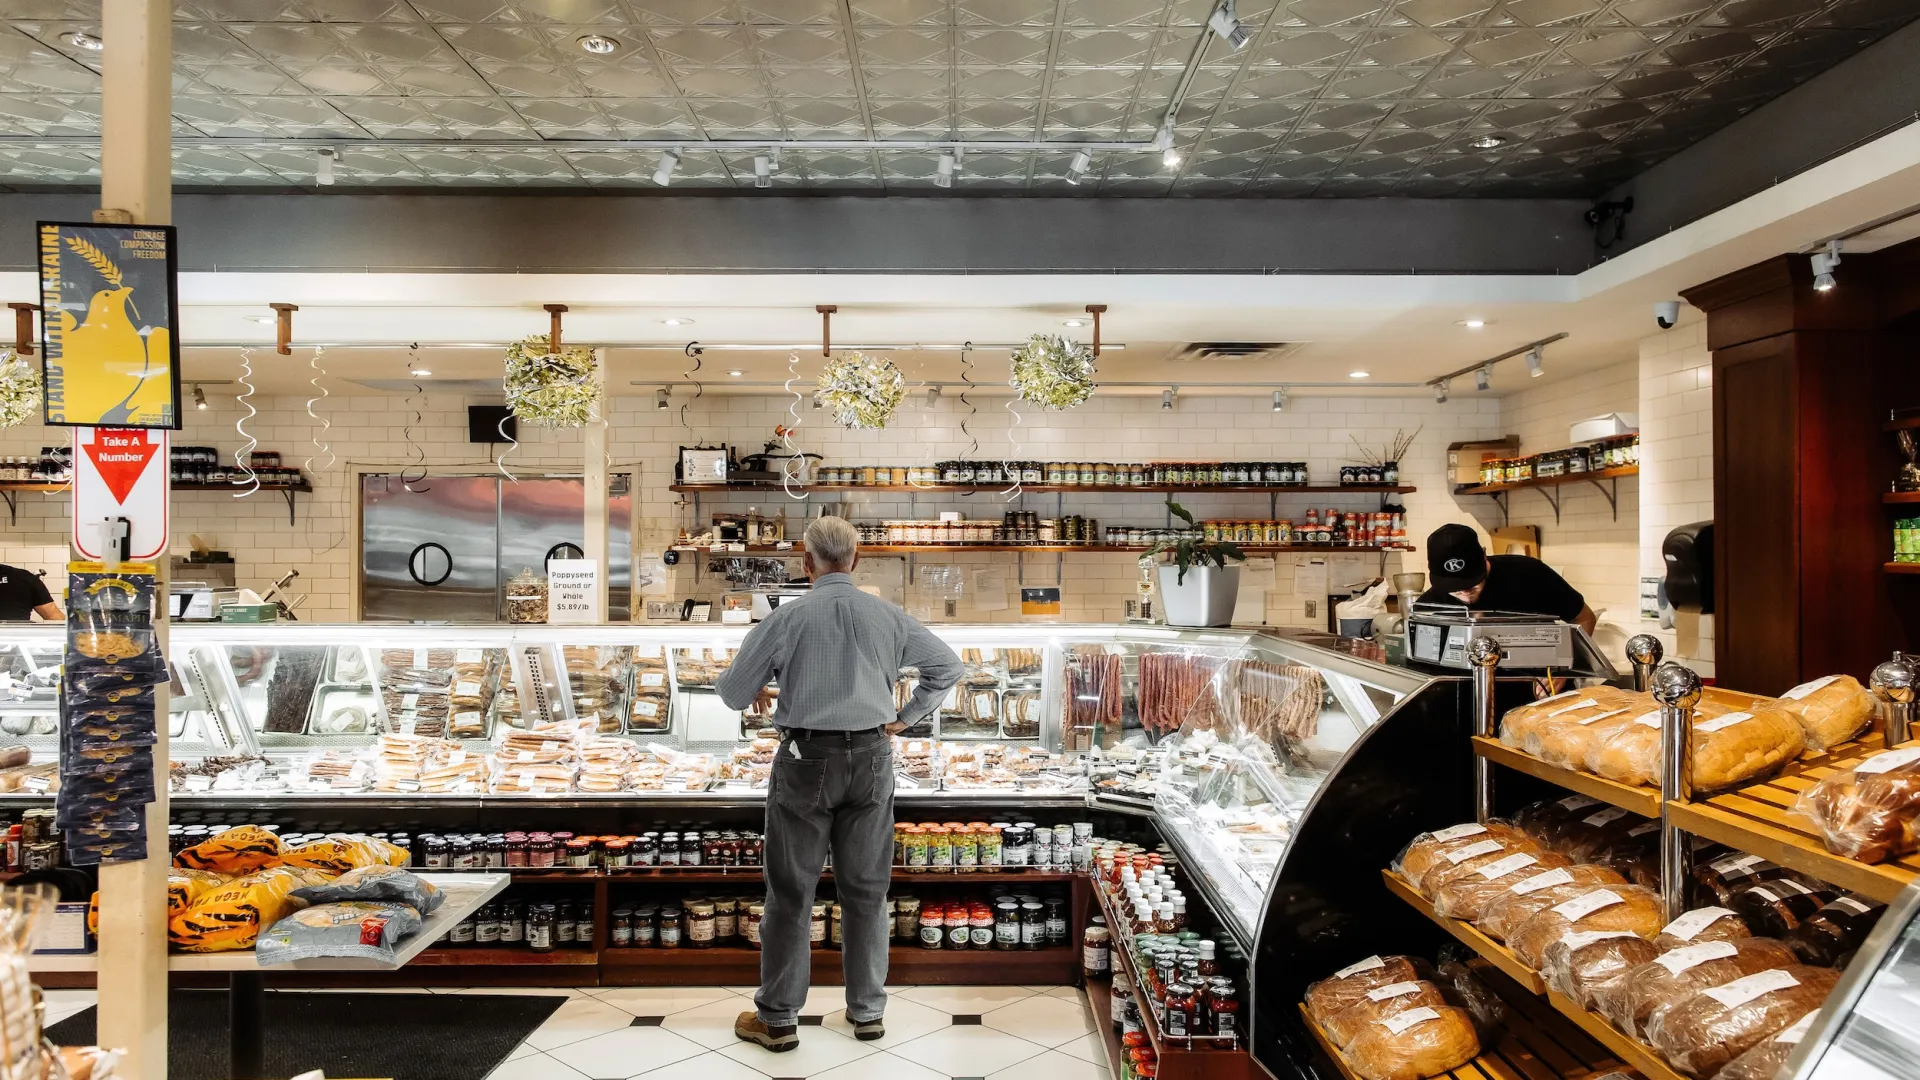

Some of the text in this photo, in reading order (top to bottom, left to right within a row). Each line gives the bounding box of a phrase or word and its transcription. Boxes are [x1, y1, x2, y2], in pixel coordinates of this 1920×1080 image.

[133, 231, 166, 240] COURAGE
[120, 240, 166, 249] COMPASSION
[133, 250, 166, 259] FREEDOM
[43, 308, 63, 358] WITH
[46, 364, 65, 424] STAND
[102, 437, 140, 446] Take A
[98, 453, 144, 462] Number
[215, 890, 250, 903] MEGA
